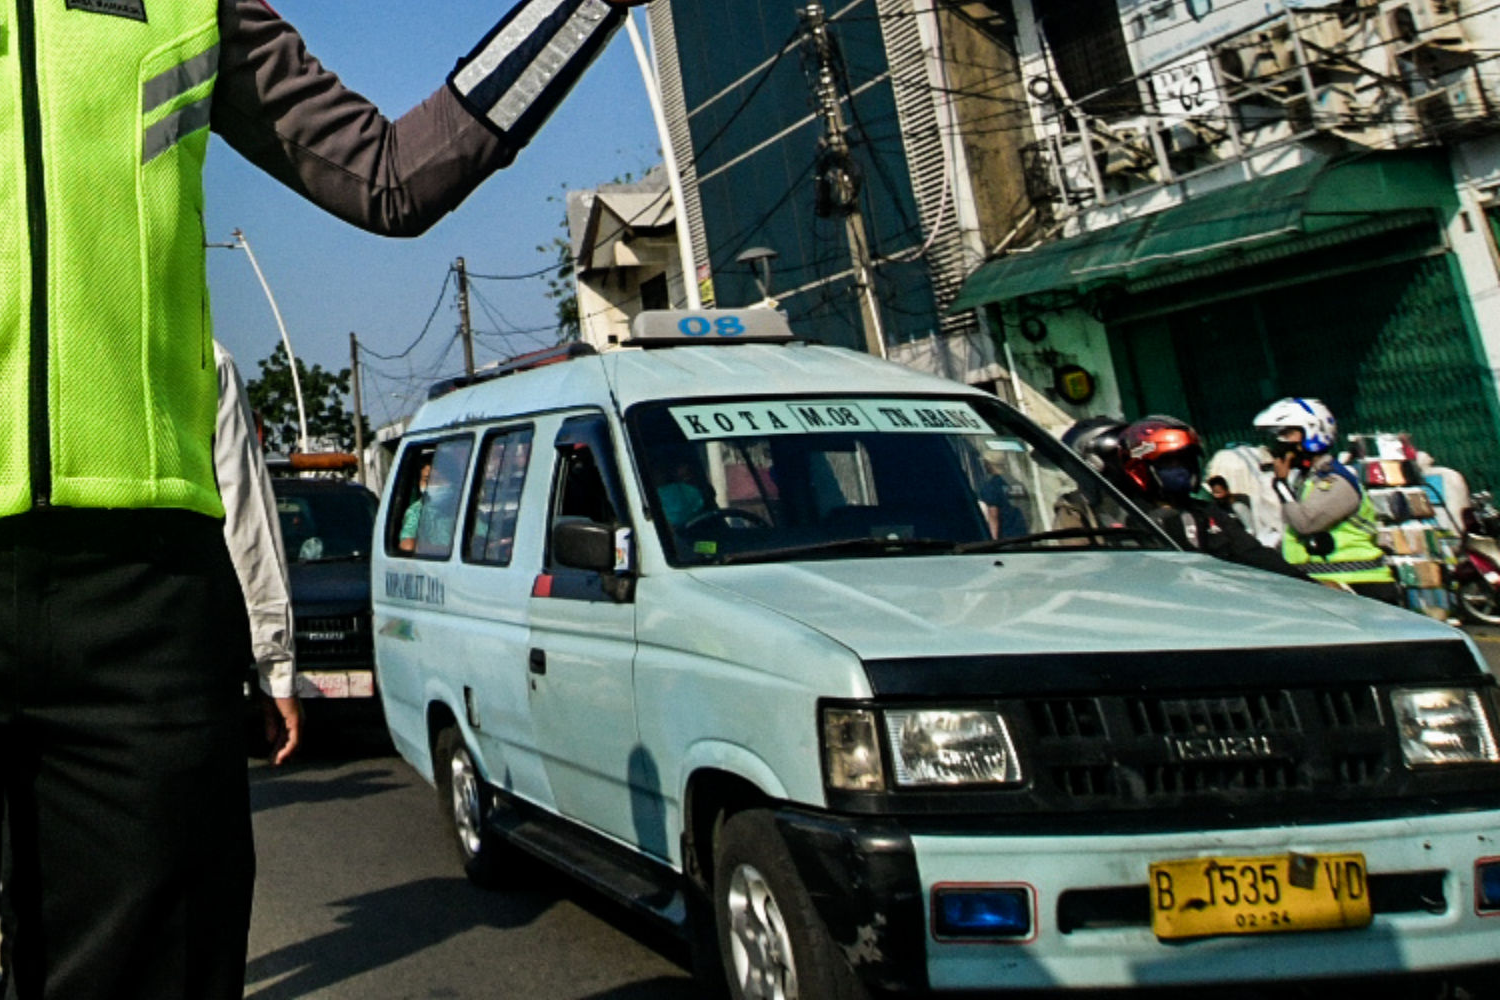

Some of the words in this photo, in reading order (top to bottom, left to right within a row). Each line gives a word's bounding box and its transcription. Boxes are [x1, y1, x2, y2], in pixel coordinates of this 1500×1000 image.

[678, 315, 746, 337] 08
[683, 409, 791, 435] KOTA
[798, 406, 861, 427] M.08
[1176, 735, 1271, 759] ISUZU
[1155, 869, 1175, 911] B
[1203, 860, 1281, 906] 1535
